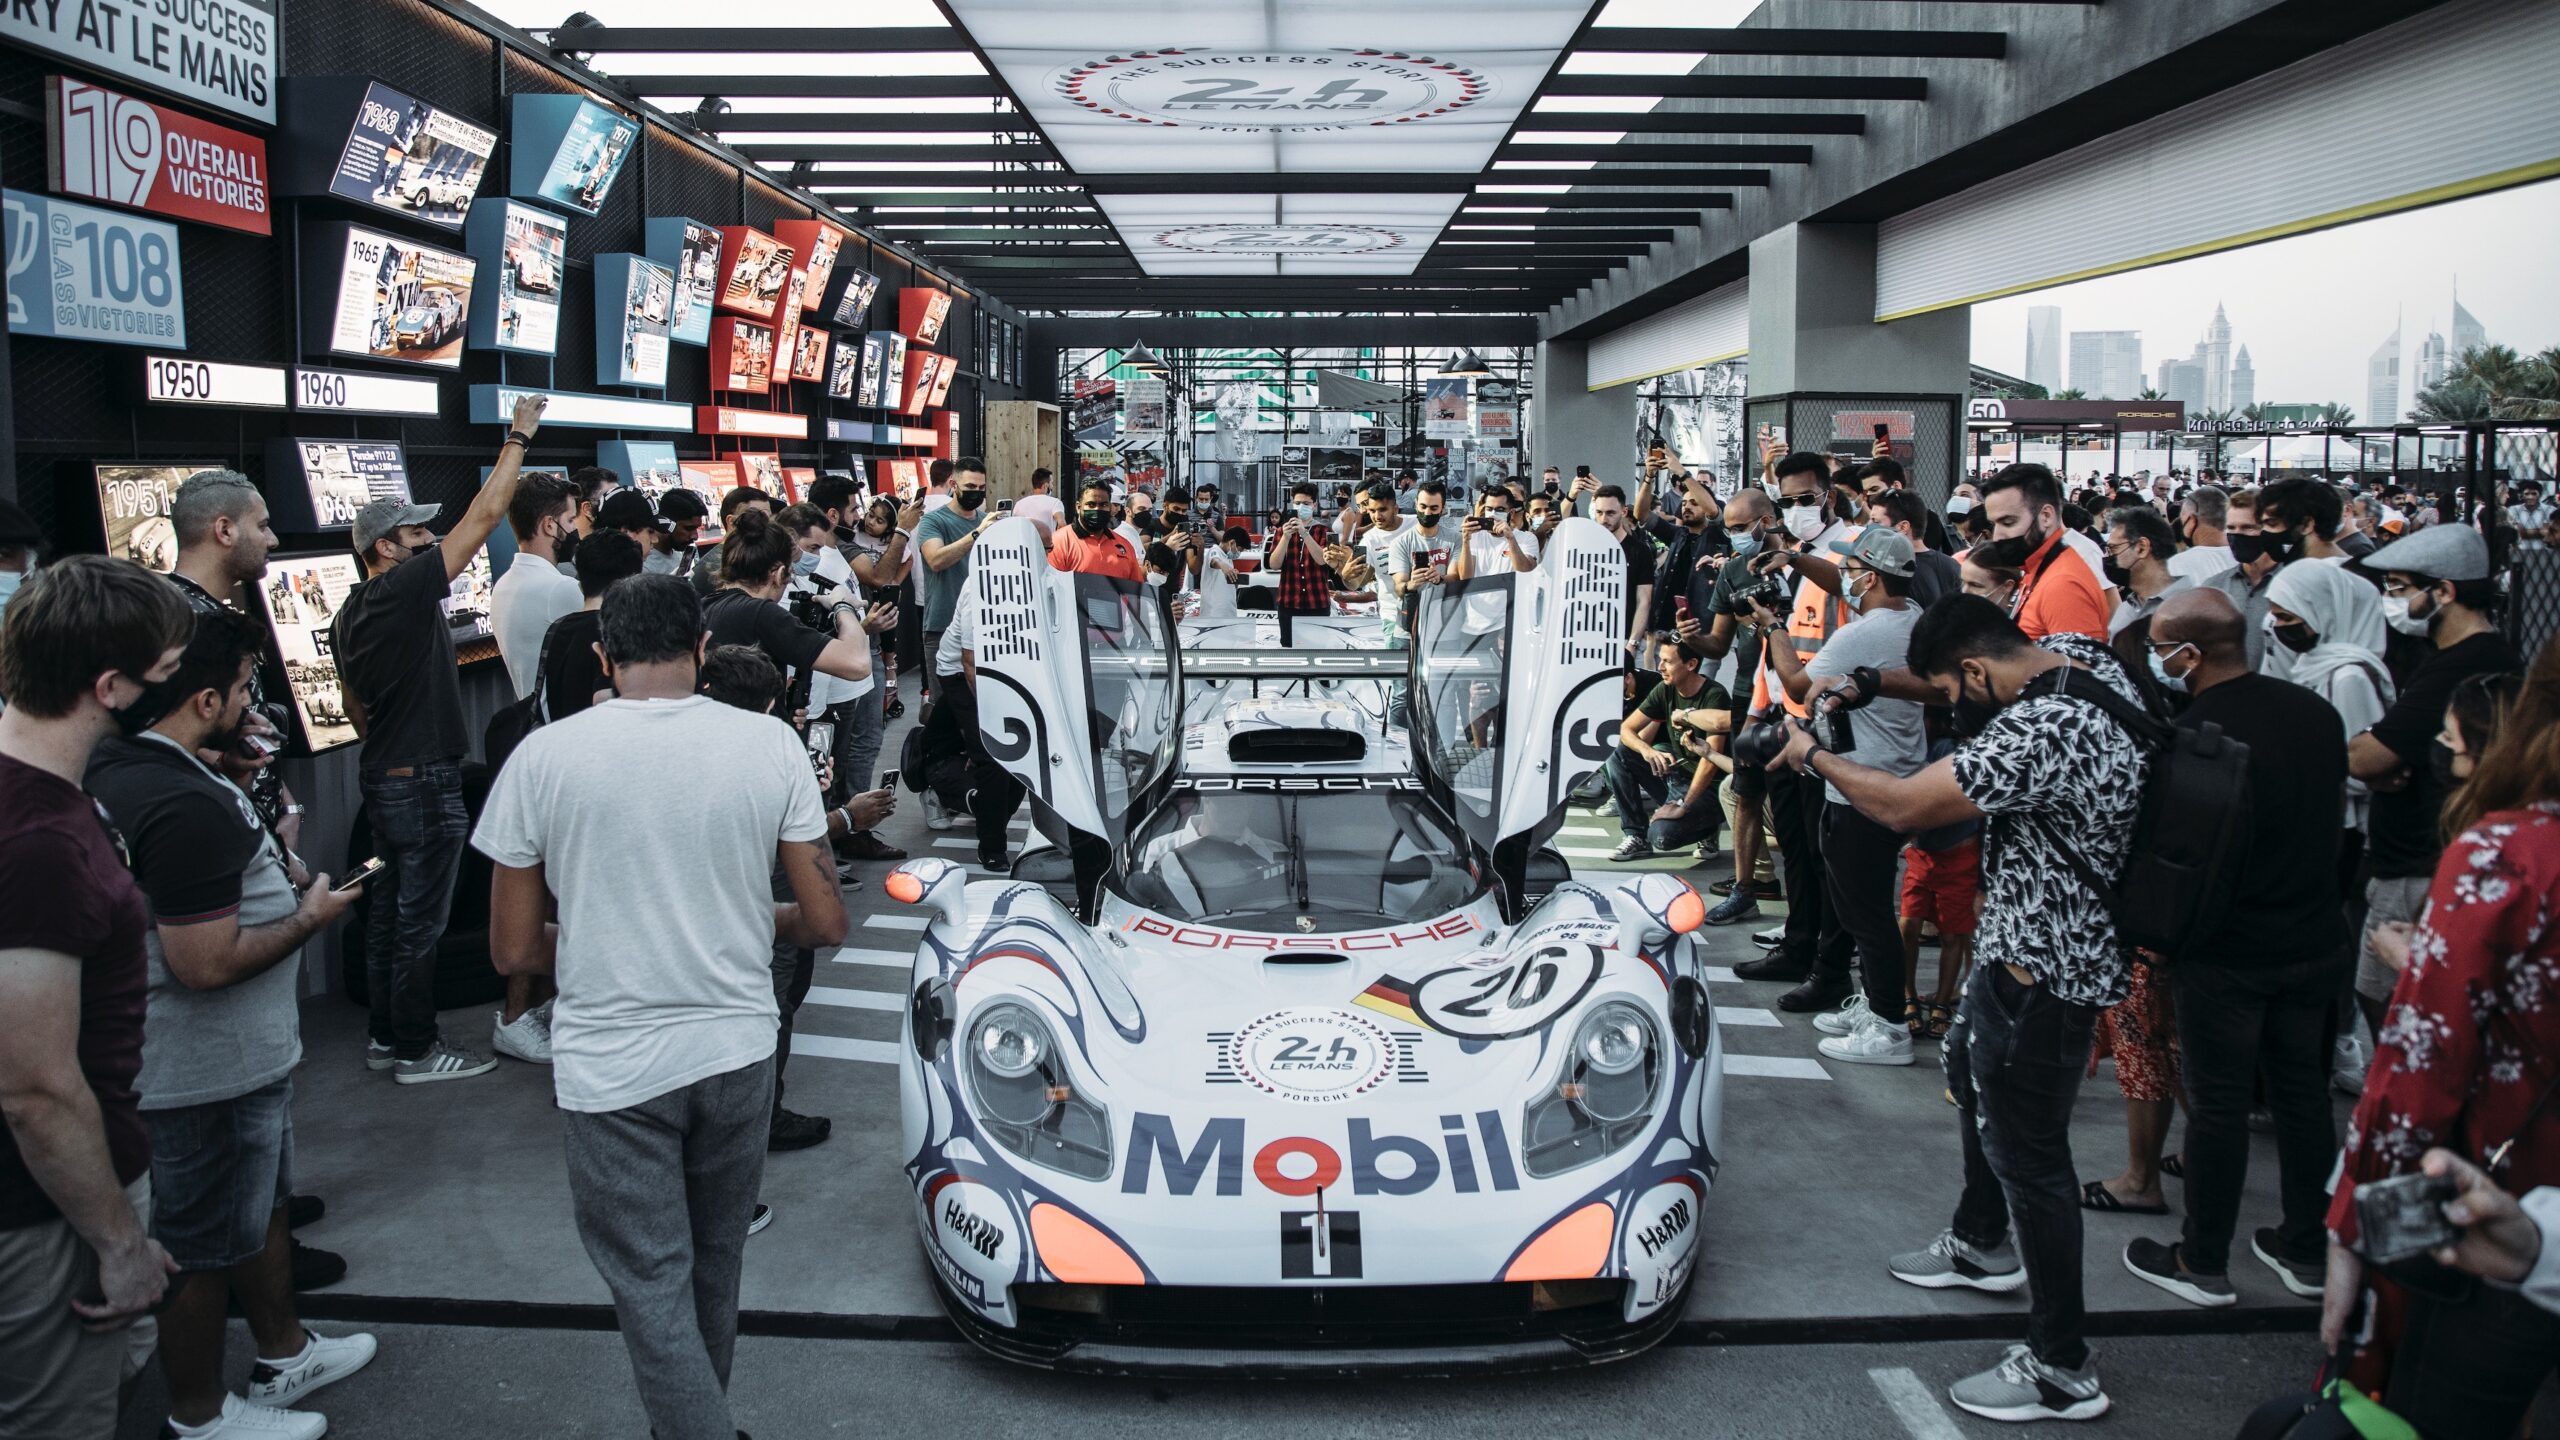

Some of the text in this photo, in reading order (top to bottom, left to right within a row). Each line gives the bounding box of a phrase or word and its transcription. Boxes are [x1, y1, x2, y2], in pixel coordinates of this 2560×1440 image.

[76, 0, 121, 54] AT
[132, 14, 170, 73] LE
[180, 34, 268, 107] MANS
[1109, 56, 1436, 83] THE SUCCESS STORY
[1167, 78, 1388, 102] 24h
[361, 101, 400, 135] 1963
[1199, 125, 1353, 133] PORSCHE
[67, 84, 162, 207] 19
[612, 125, 632, 143] 1971
[166, 131, 263, 186] OVERALL
[168, 163, 266, 213] VICTORIES
[75, 221, 173, 308] 108
[353, 240, 379, 264] 1965
[50, 213, 77, 326] CLASS
[77, 303, 176, 337] VICTORIES
[152, 362, 210, 399] 1950
[300, 371, 346, 407] 1960
[720, 411, 737, 430] 1980
[1971, 403, 2000, 418] 50
[351, 450, 375, 461] Porsche
[106, 478, 171, 518] 1951
[315, 495, 357, 521] 1966
[977, 543, 1041, 662] IBM
[1246, 612, 1279, 620] DUN
[1561, 548, 1621, 666] IBM
[475, 615, 494, 635] 196
[1171, 778, 1425, 791] PORSCHE
[1132, 913, 1474, 951] PORSCHE
[1554, 923, 1574, 931] DU
[1575, 922, 1615, 930] MANS
[1560, 932, 1579, 940] 98
[1439, 946, 1568, 1017] 26
[1254, 1017, 1371, 1041] THE SUCCESS STORY
[1273, 1036, 1358, 1061] 24h
[1269, 1062, 1354, 1071] LE MANS
[1282, 1091, 1351, 1103] PORSCHE
[1121, 1109, 1521, 1197] Mobil
[1300, 1212, 1332, 1276] 1
[925, 1231, 981, 1299] MICHELIN
